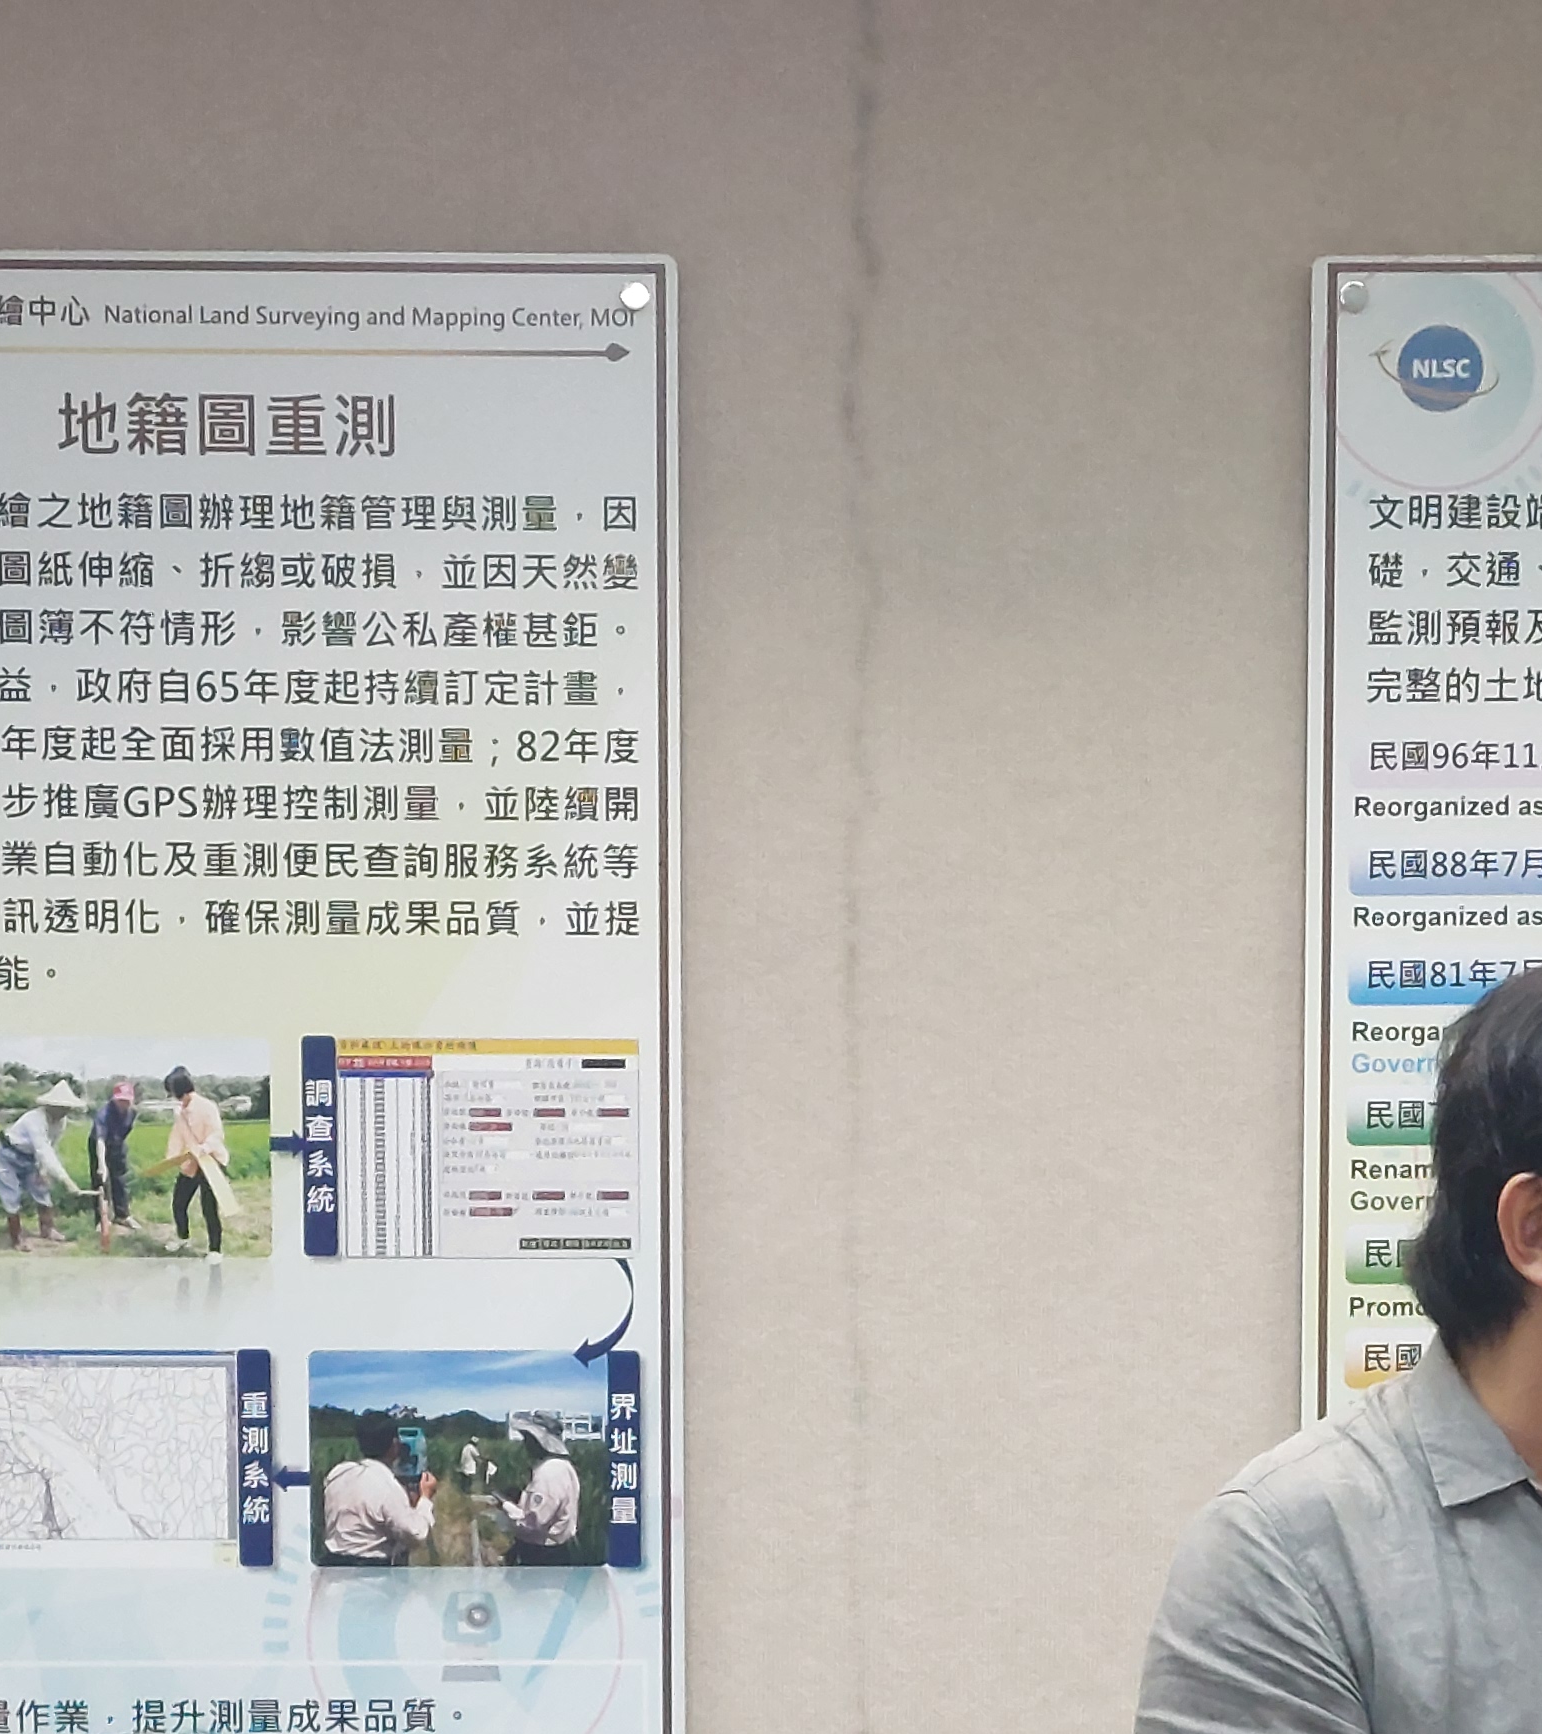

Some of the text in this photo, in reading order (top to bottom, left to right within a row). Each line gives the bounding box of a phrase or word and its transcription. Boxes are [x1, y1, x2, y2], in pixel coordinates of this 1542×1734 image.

[104, 304, 193, 325] National
[199, 304, 249, 325] Land
[255, 305, 360, 332] Surveying
[366, 305, 405, 326] and
[412, 306, 505, 333] Mapping
[511, 307, 583, 330] Center,
[590, 307, 637, 328] MOI
[1411, 357, 1471, 380] NLSC
[57, 391, 395, 458] 地籍圖重測
[1354, 794, 1510, 822] Reorganized
[1353, 904, 1508, 932] Reorganized
[1352, 1021, 1444, 1046] Reorga
[1367, 1100, 1437, 1129] 民國
[304, 1078, 335, 1216] 調查系統
[1351, 1191, 1433, 1211] Gover
[240, 1390, 271, 1525] 重測系統
[609, 1392, 638, 1525] 界址測量
